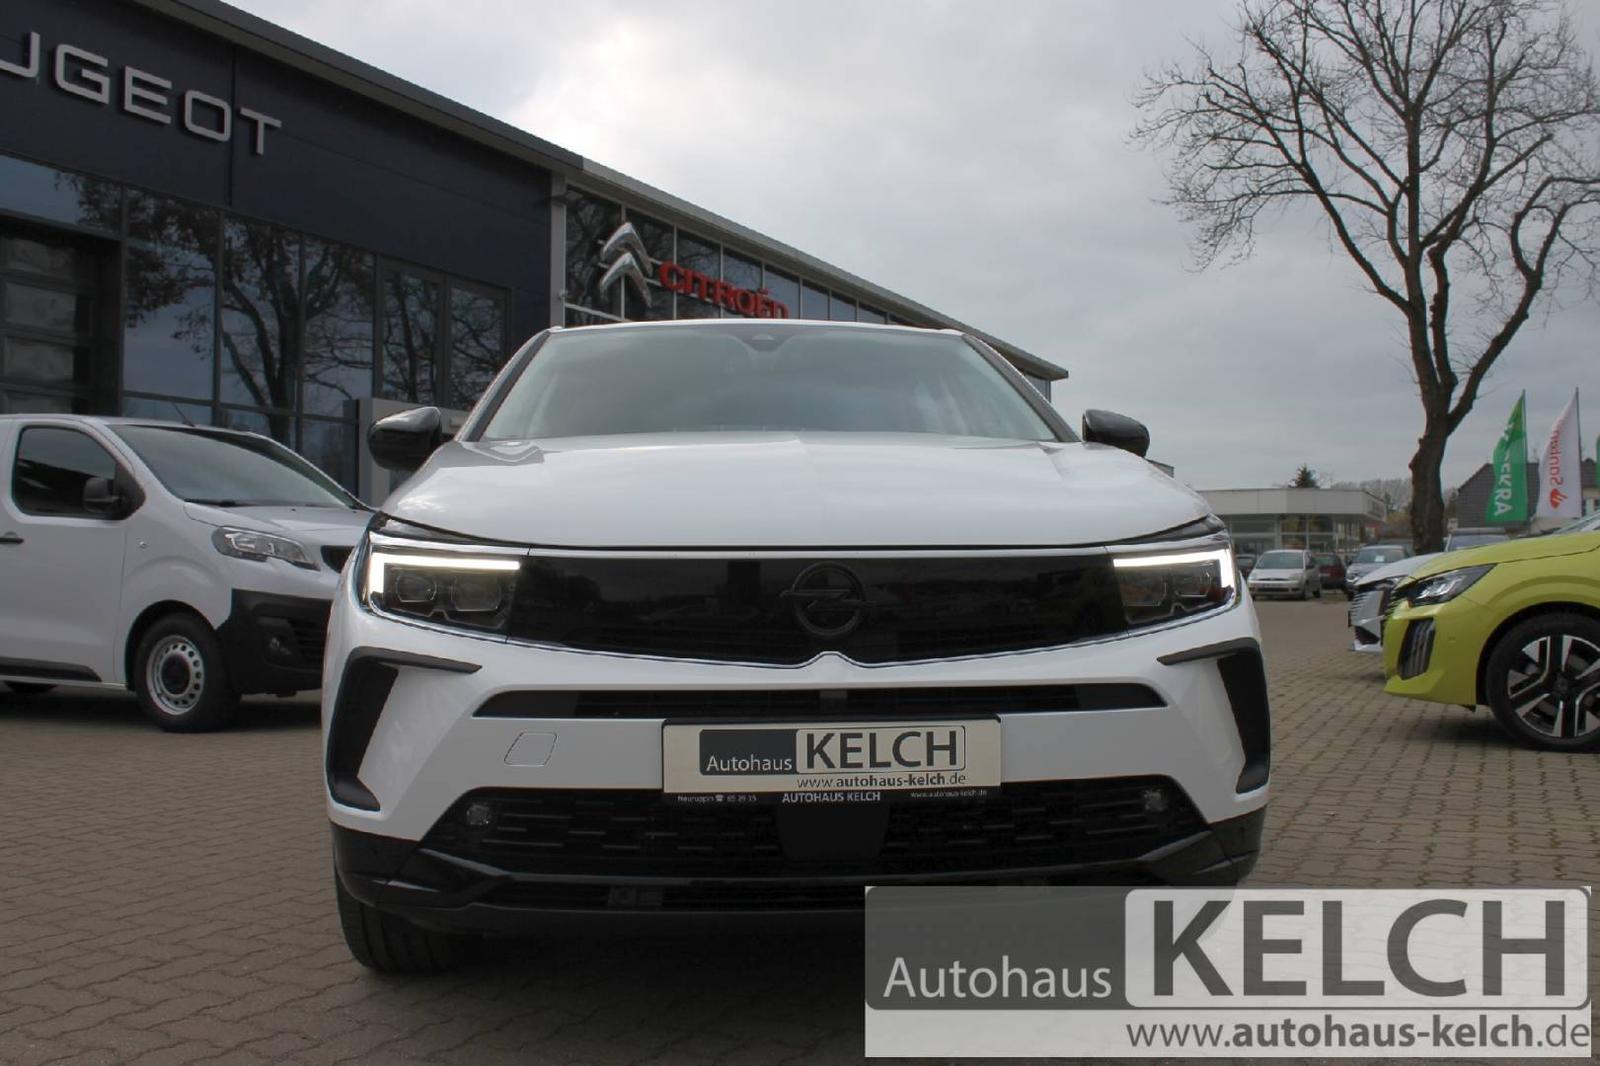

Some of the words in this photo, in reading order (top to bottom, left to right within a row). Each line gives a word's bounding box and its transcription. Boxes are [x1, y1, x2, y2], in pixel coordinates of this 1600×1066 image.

[706, 755, 793, 773] Autohaus
[806, 731, 957, 769] KELCH
[797, 772, 967, 788] www.autohaus-kelch.de
[782, 792, 844, 803] AUTOHAUS
[847, 791, 881, 801] KELCH
